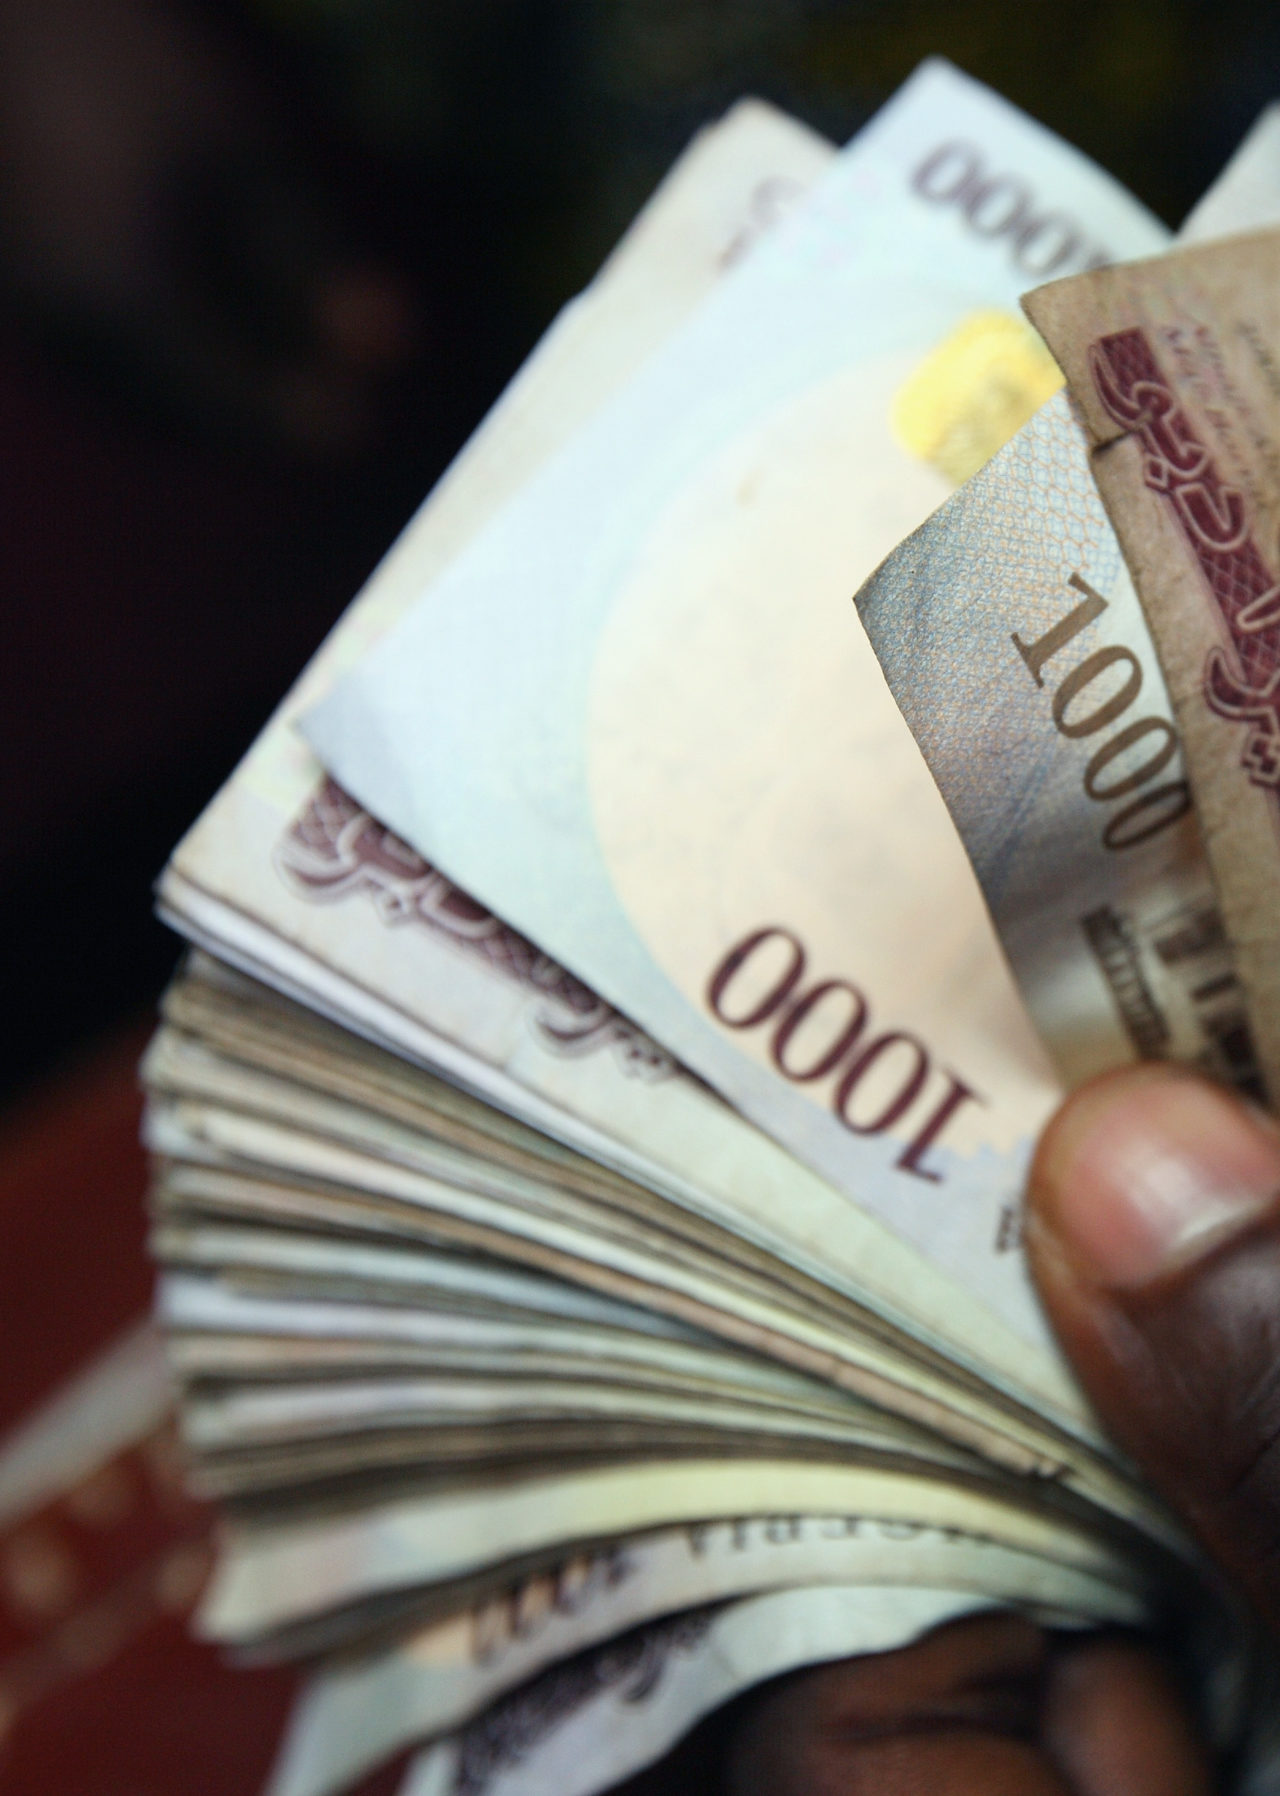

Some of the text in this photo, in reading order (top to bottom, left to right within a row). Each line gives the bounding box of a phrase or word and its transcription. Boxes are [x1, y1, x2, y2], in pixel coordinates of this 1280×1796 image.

[910, 138, 1110, 277] 000
[1010, 571, 1194, 851] 1000
[705, 924, 992, 1186] 1000
